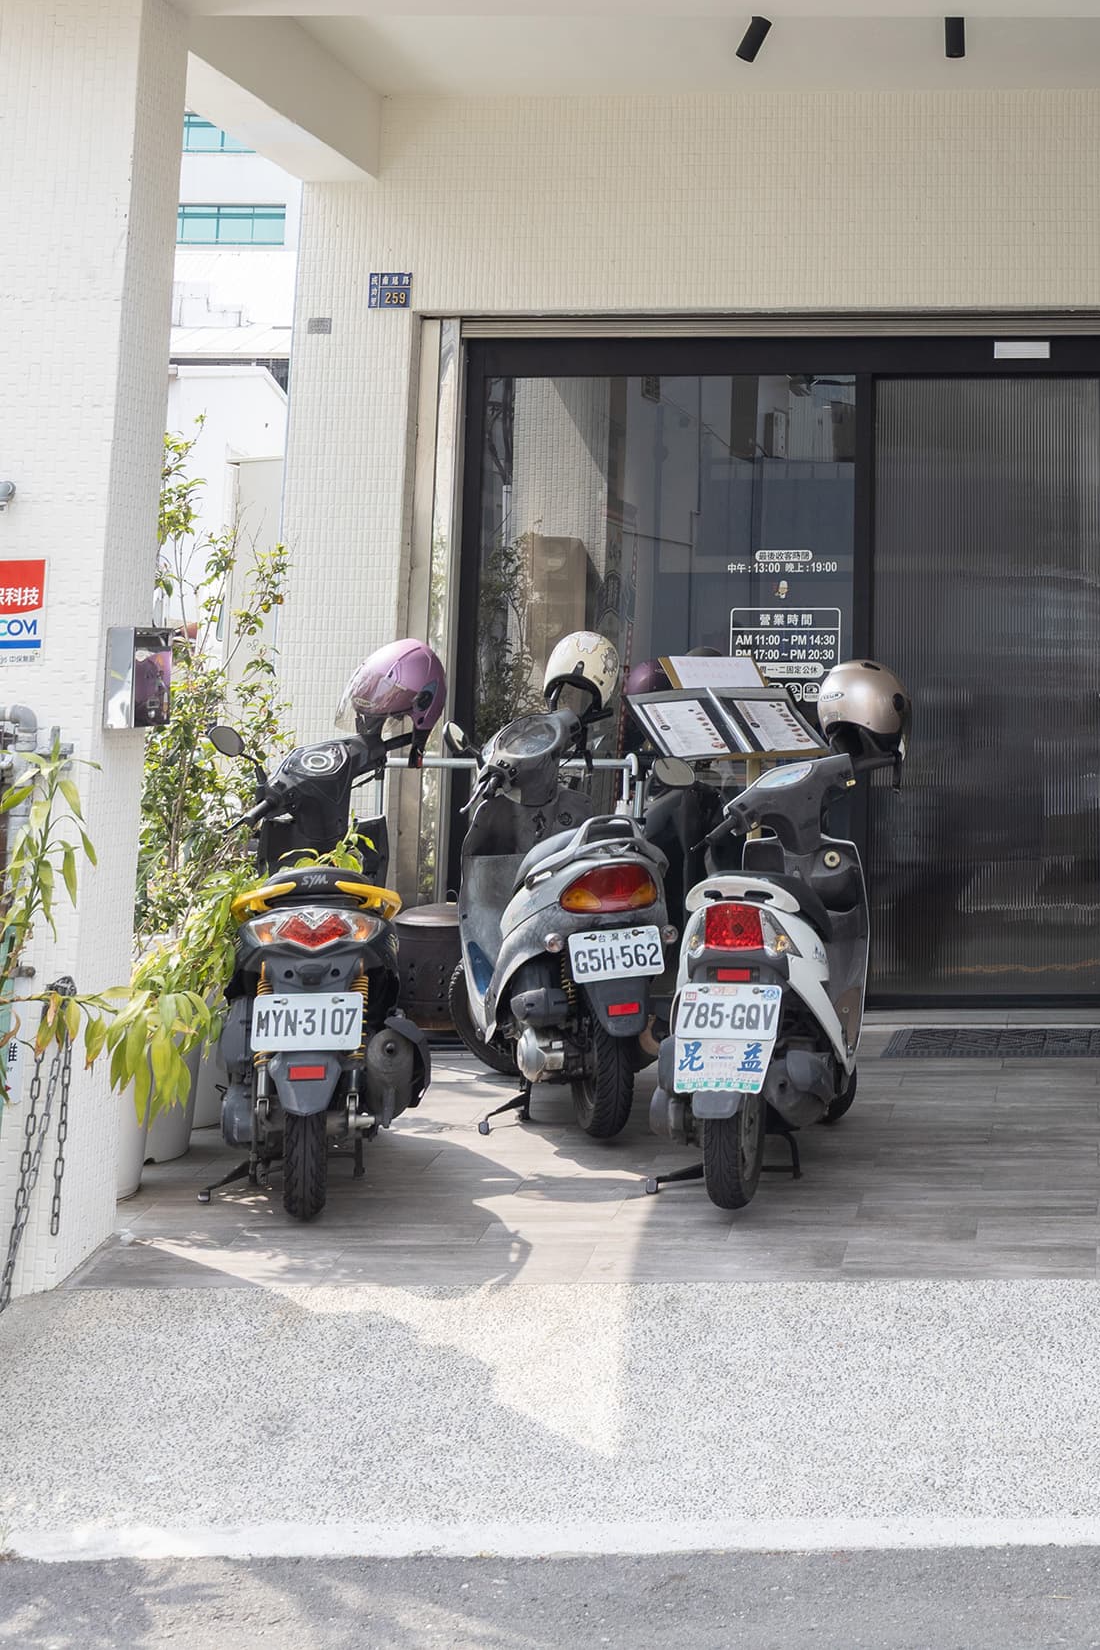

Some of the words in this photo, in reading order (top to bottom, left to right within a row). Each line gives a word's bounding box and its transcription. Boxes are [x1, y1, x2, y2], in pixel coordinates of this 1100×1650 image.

[384, 292, 406, 304] 259
[0, 587, 39, 606] 科技
[759, 614, 813, 626] 營業時間
[736, 635, 752, 645] AM
[755, 635, 780, 646] 11:00
[791, 635, 807, 645] PM
[810, 635, 835, 645] 14:30
[754, 650, 779, 660] 17:00
[790, 650, 806, 660] PM
[808, 650, 834, 660] 20:30
[301, 874, 328, 888] SYM
[598, 931, 631, 943] 台灣省
